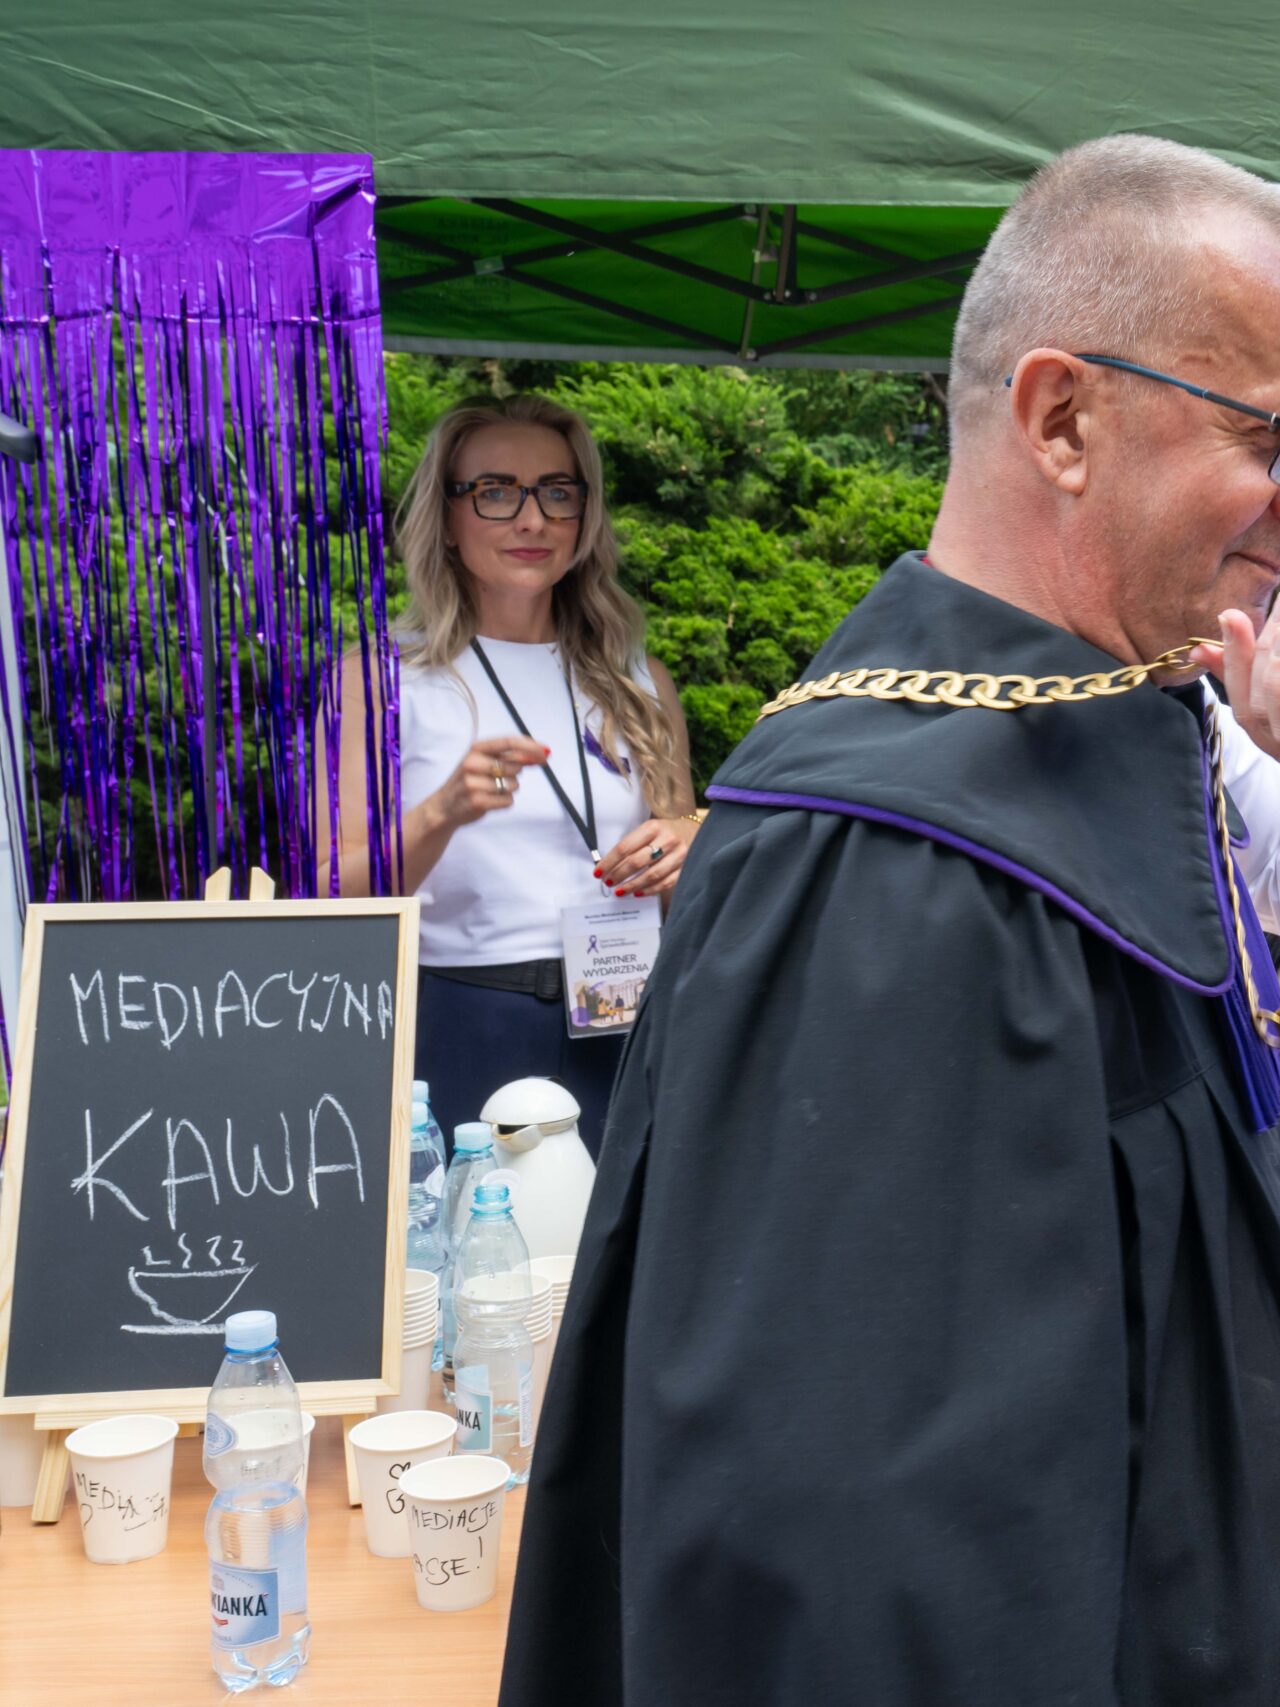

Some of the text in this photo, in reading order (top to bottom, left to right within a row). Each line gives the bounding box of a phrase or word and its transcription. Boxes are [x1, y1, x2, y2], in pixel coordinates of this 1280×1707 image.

[583, 963, 649, 978] WYDARZENIA
[593, 954, 637, 966] PARTNER
[70, 969, 393, 1050] MEDIACYJNA
[71, 1093, 365, 1231] KAWA
[456, 1408, 481, 1431] NKA
